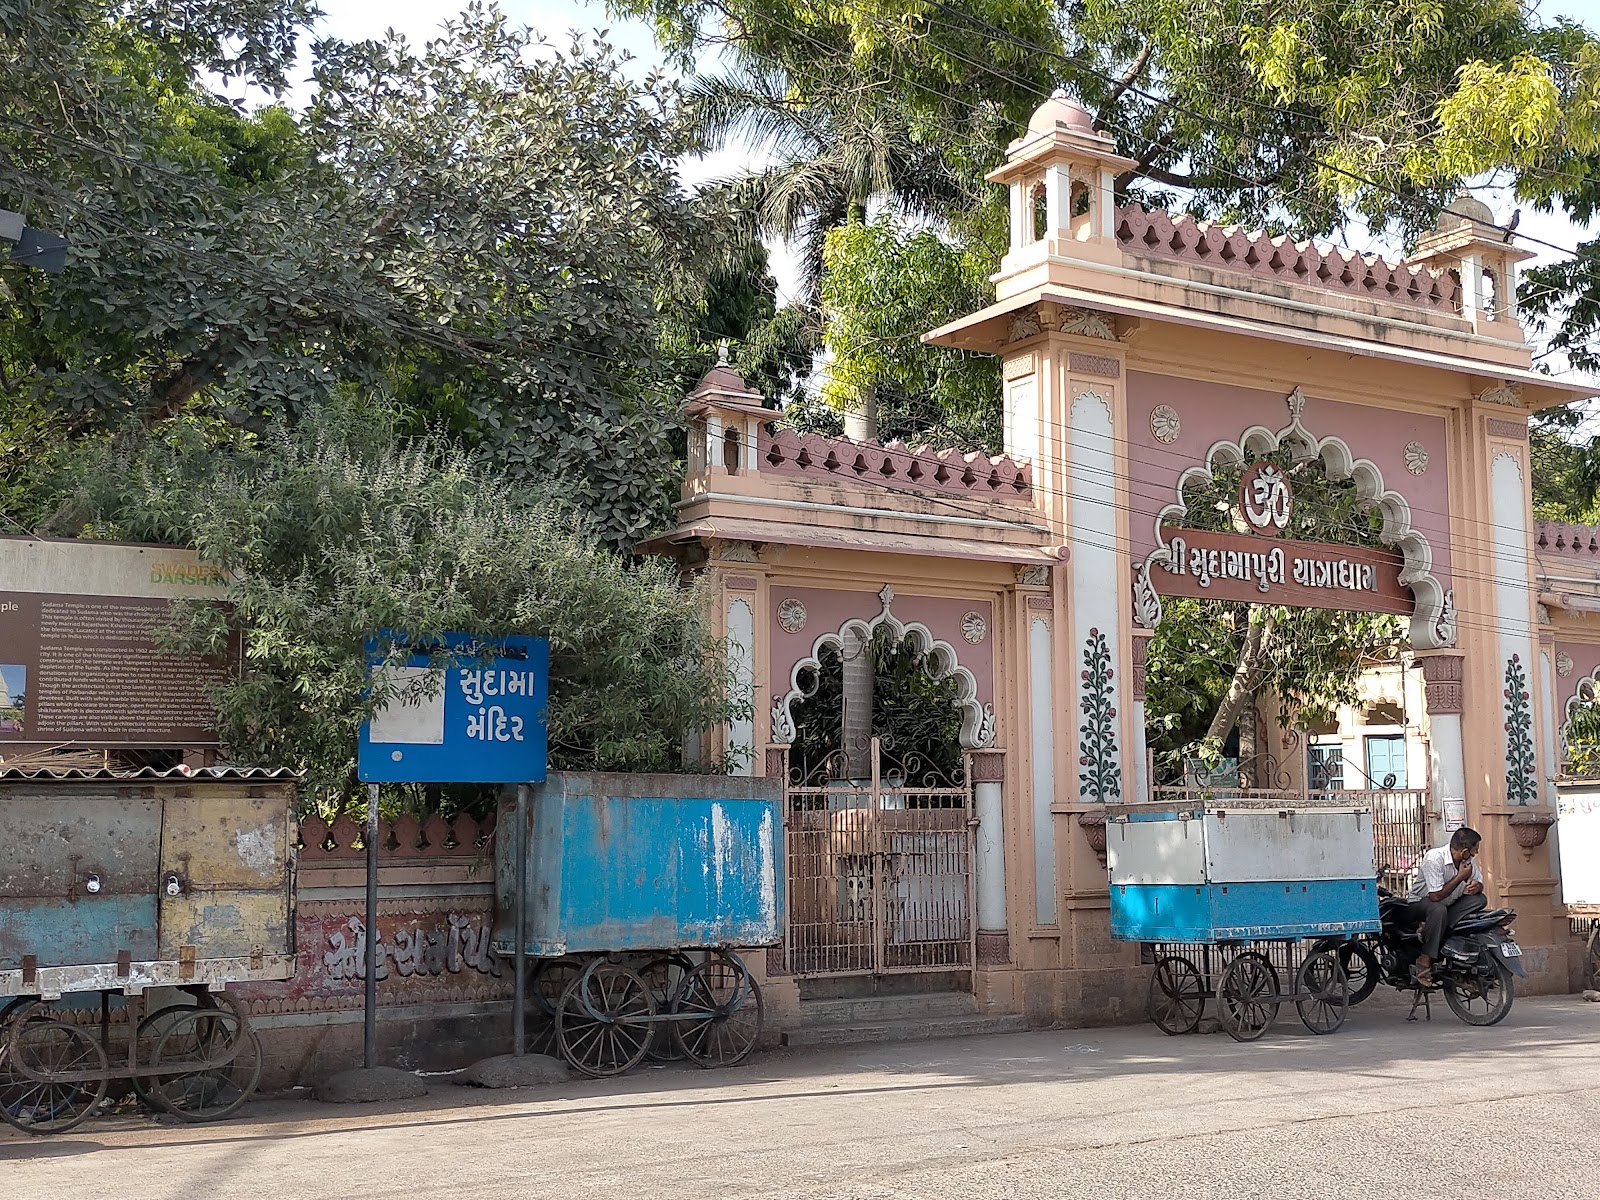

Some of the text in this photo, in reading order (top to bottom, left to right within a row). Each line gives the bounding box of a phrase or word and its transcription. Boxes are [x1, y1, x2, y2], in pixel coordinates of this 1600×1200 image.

[1189, 547, 1286, 593] સુદામાપુરી
[1293, 558, 1378, 592] યાત્રાધામ
[459, 669, 534, 705] સુદામા
[466, 705, 524, 742] મંદિર
